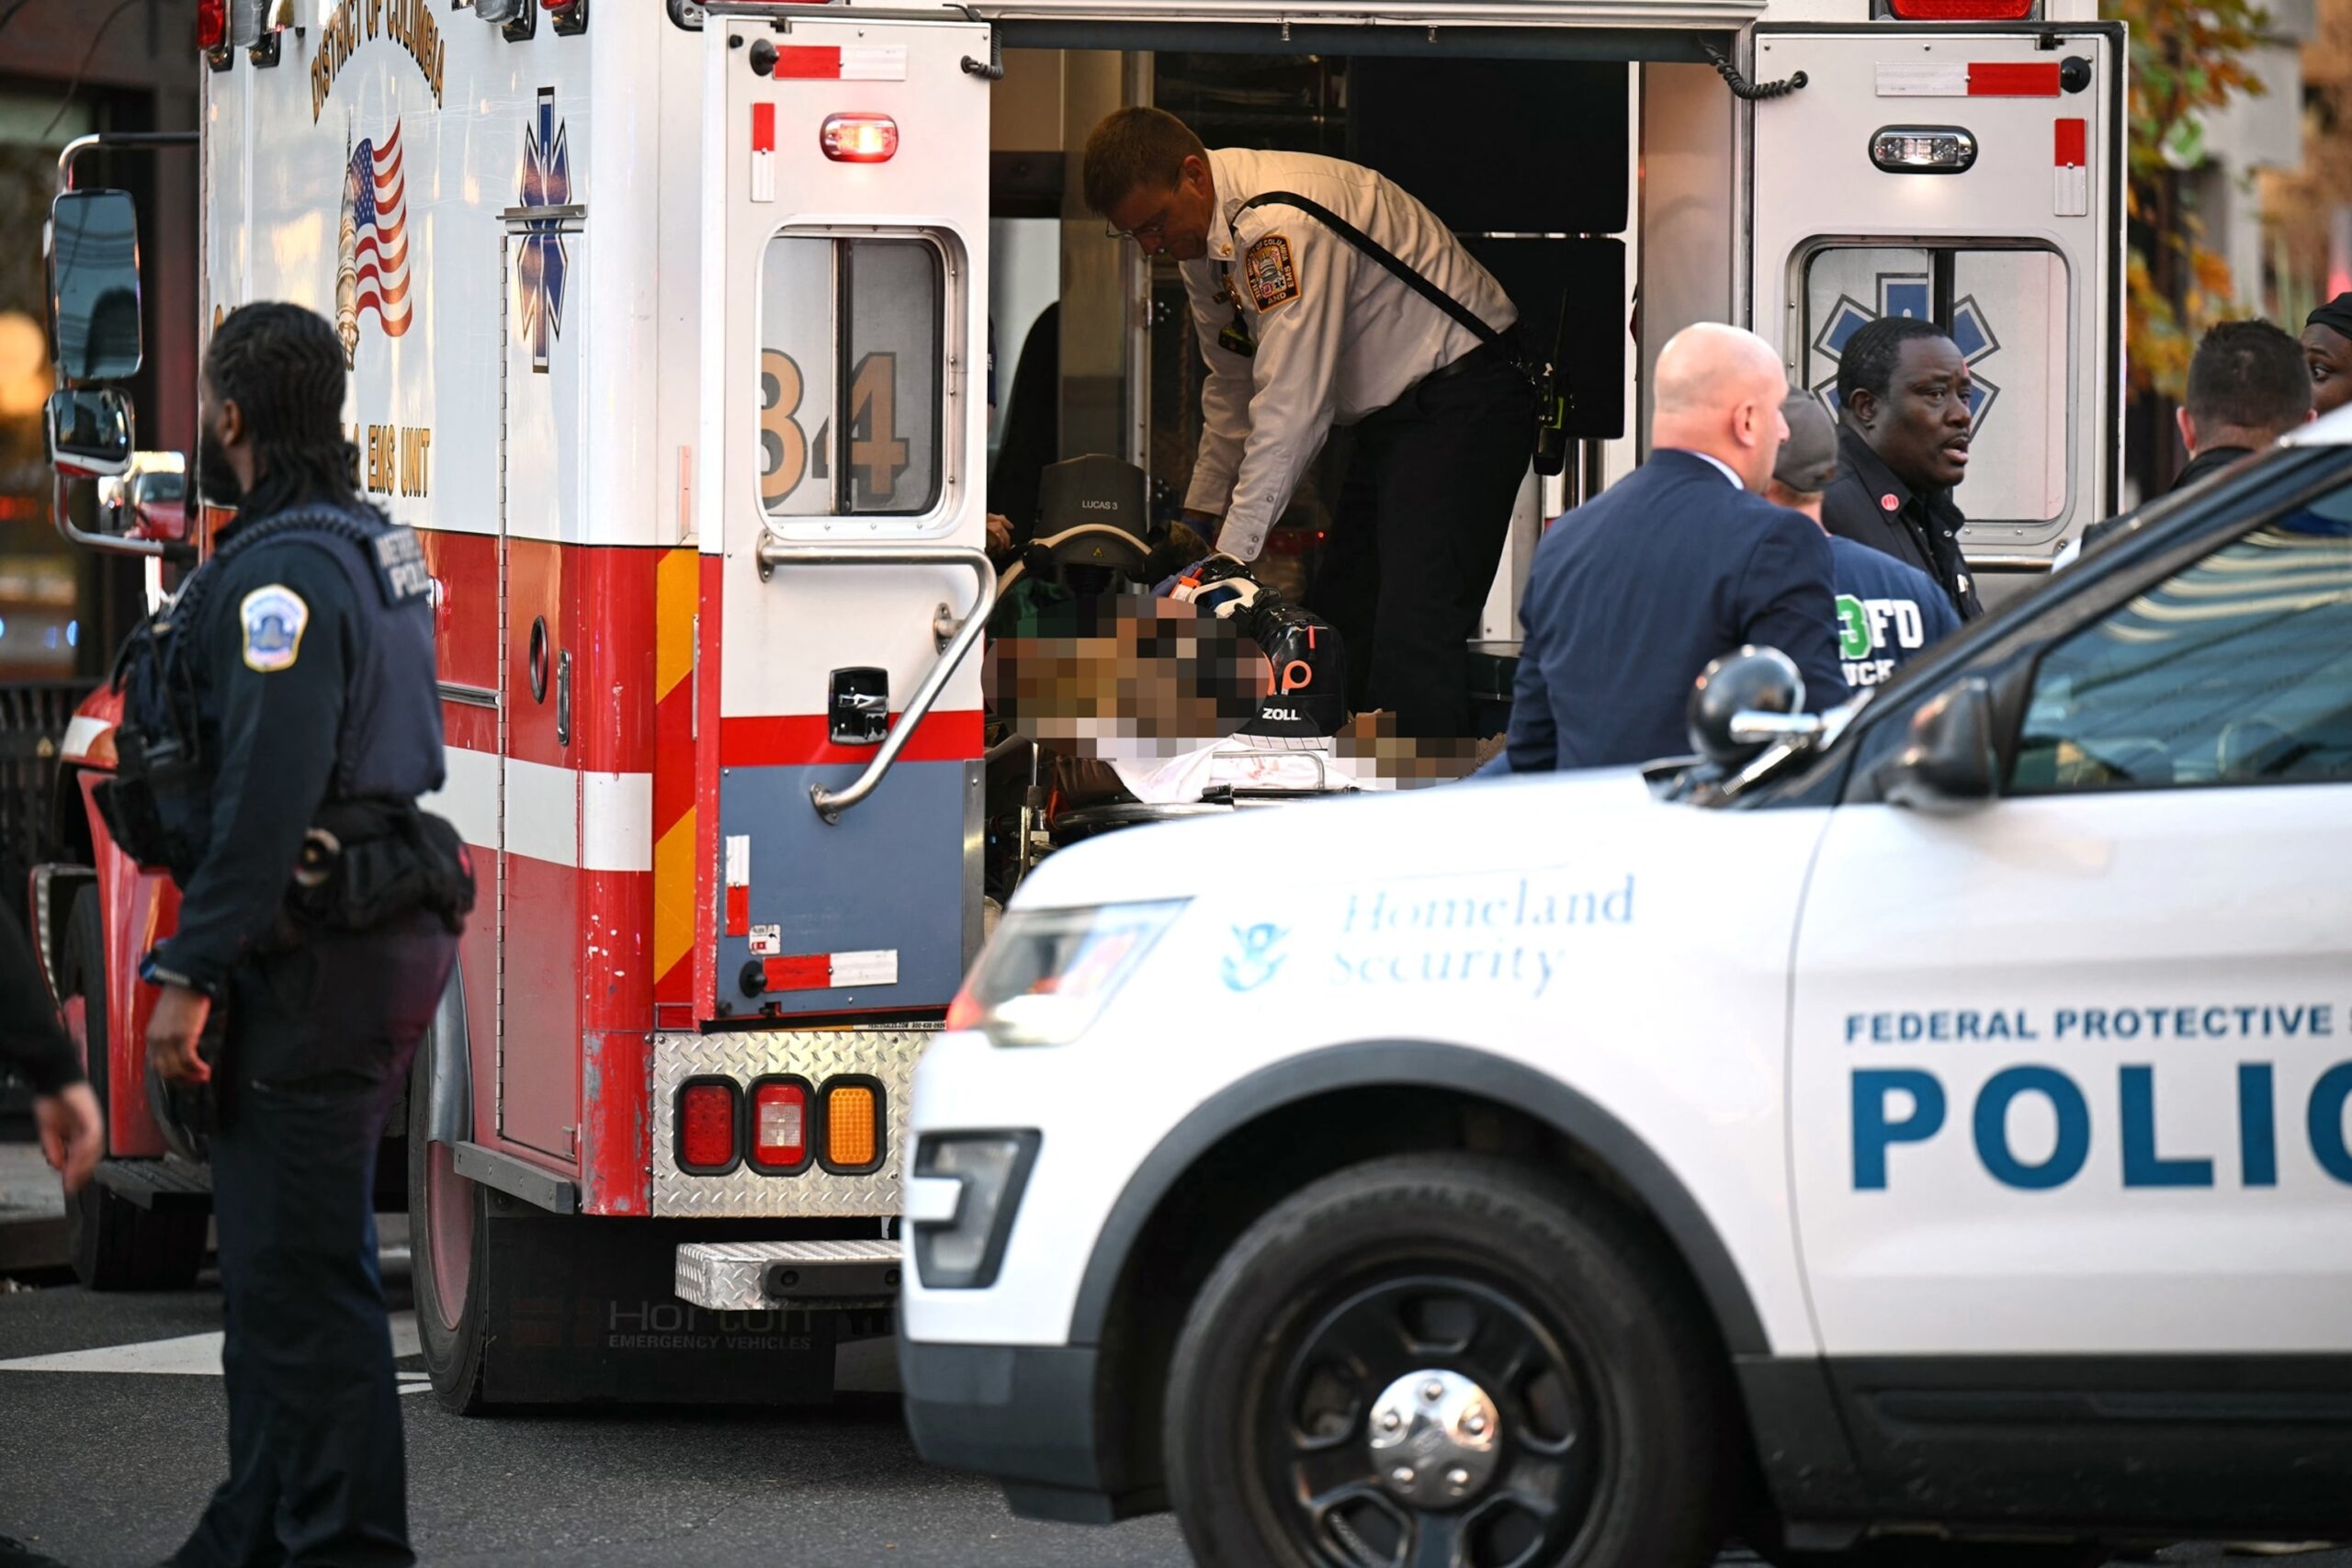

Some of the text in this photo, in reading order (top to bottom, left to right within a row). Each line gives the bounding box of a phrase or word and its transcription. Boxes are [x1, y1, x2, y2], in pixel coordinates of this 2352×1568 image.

[311, 0, 361, 126] DISTRICT
[387, 0, 445, 110] COLUMBIA
[1268, 291, 1286, 304] AND
[1283, 265, 1295, 288] EMS
[368, 424, 396, 496] EMS
[401, 426, 431, 498] UNIT
[1081, 501, 1118, 510] LUCAS 3
[1261, 707, 1299, 721] ZOLL
[1343, 872, 1635, 933] Homeland
[1329, 935, 1566, 1000] Security
[1845, 1010, 2039, 1043] FEDERAL
[2055, 1005, 2334, 1039] PROTECTIVE
[610, 1300, 812, 1332] Horton
[608, 1334, 811, 1350] EMERGENCY VEHICLES
